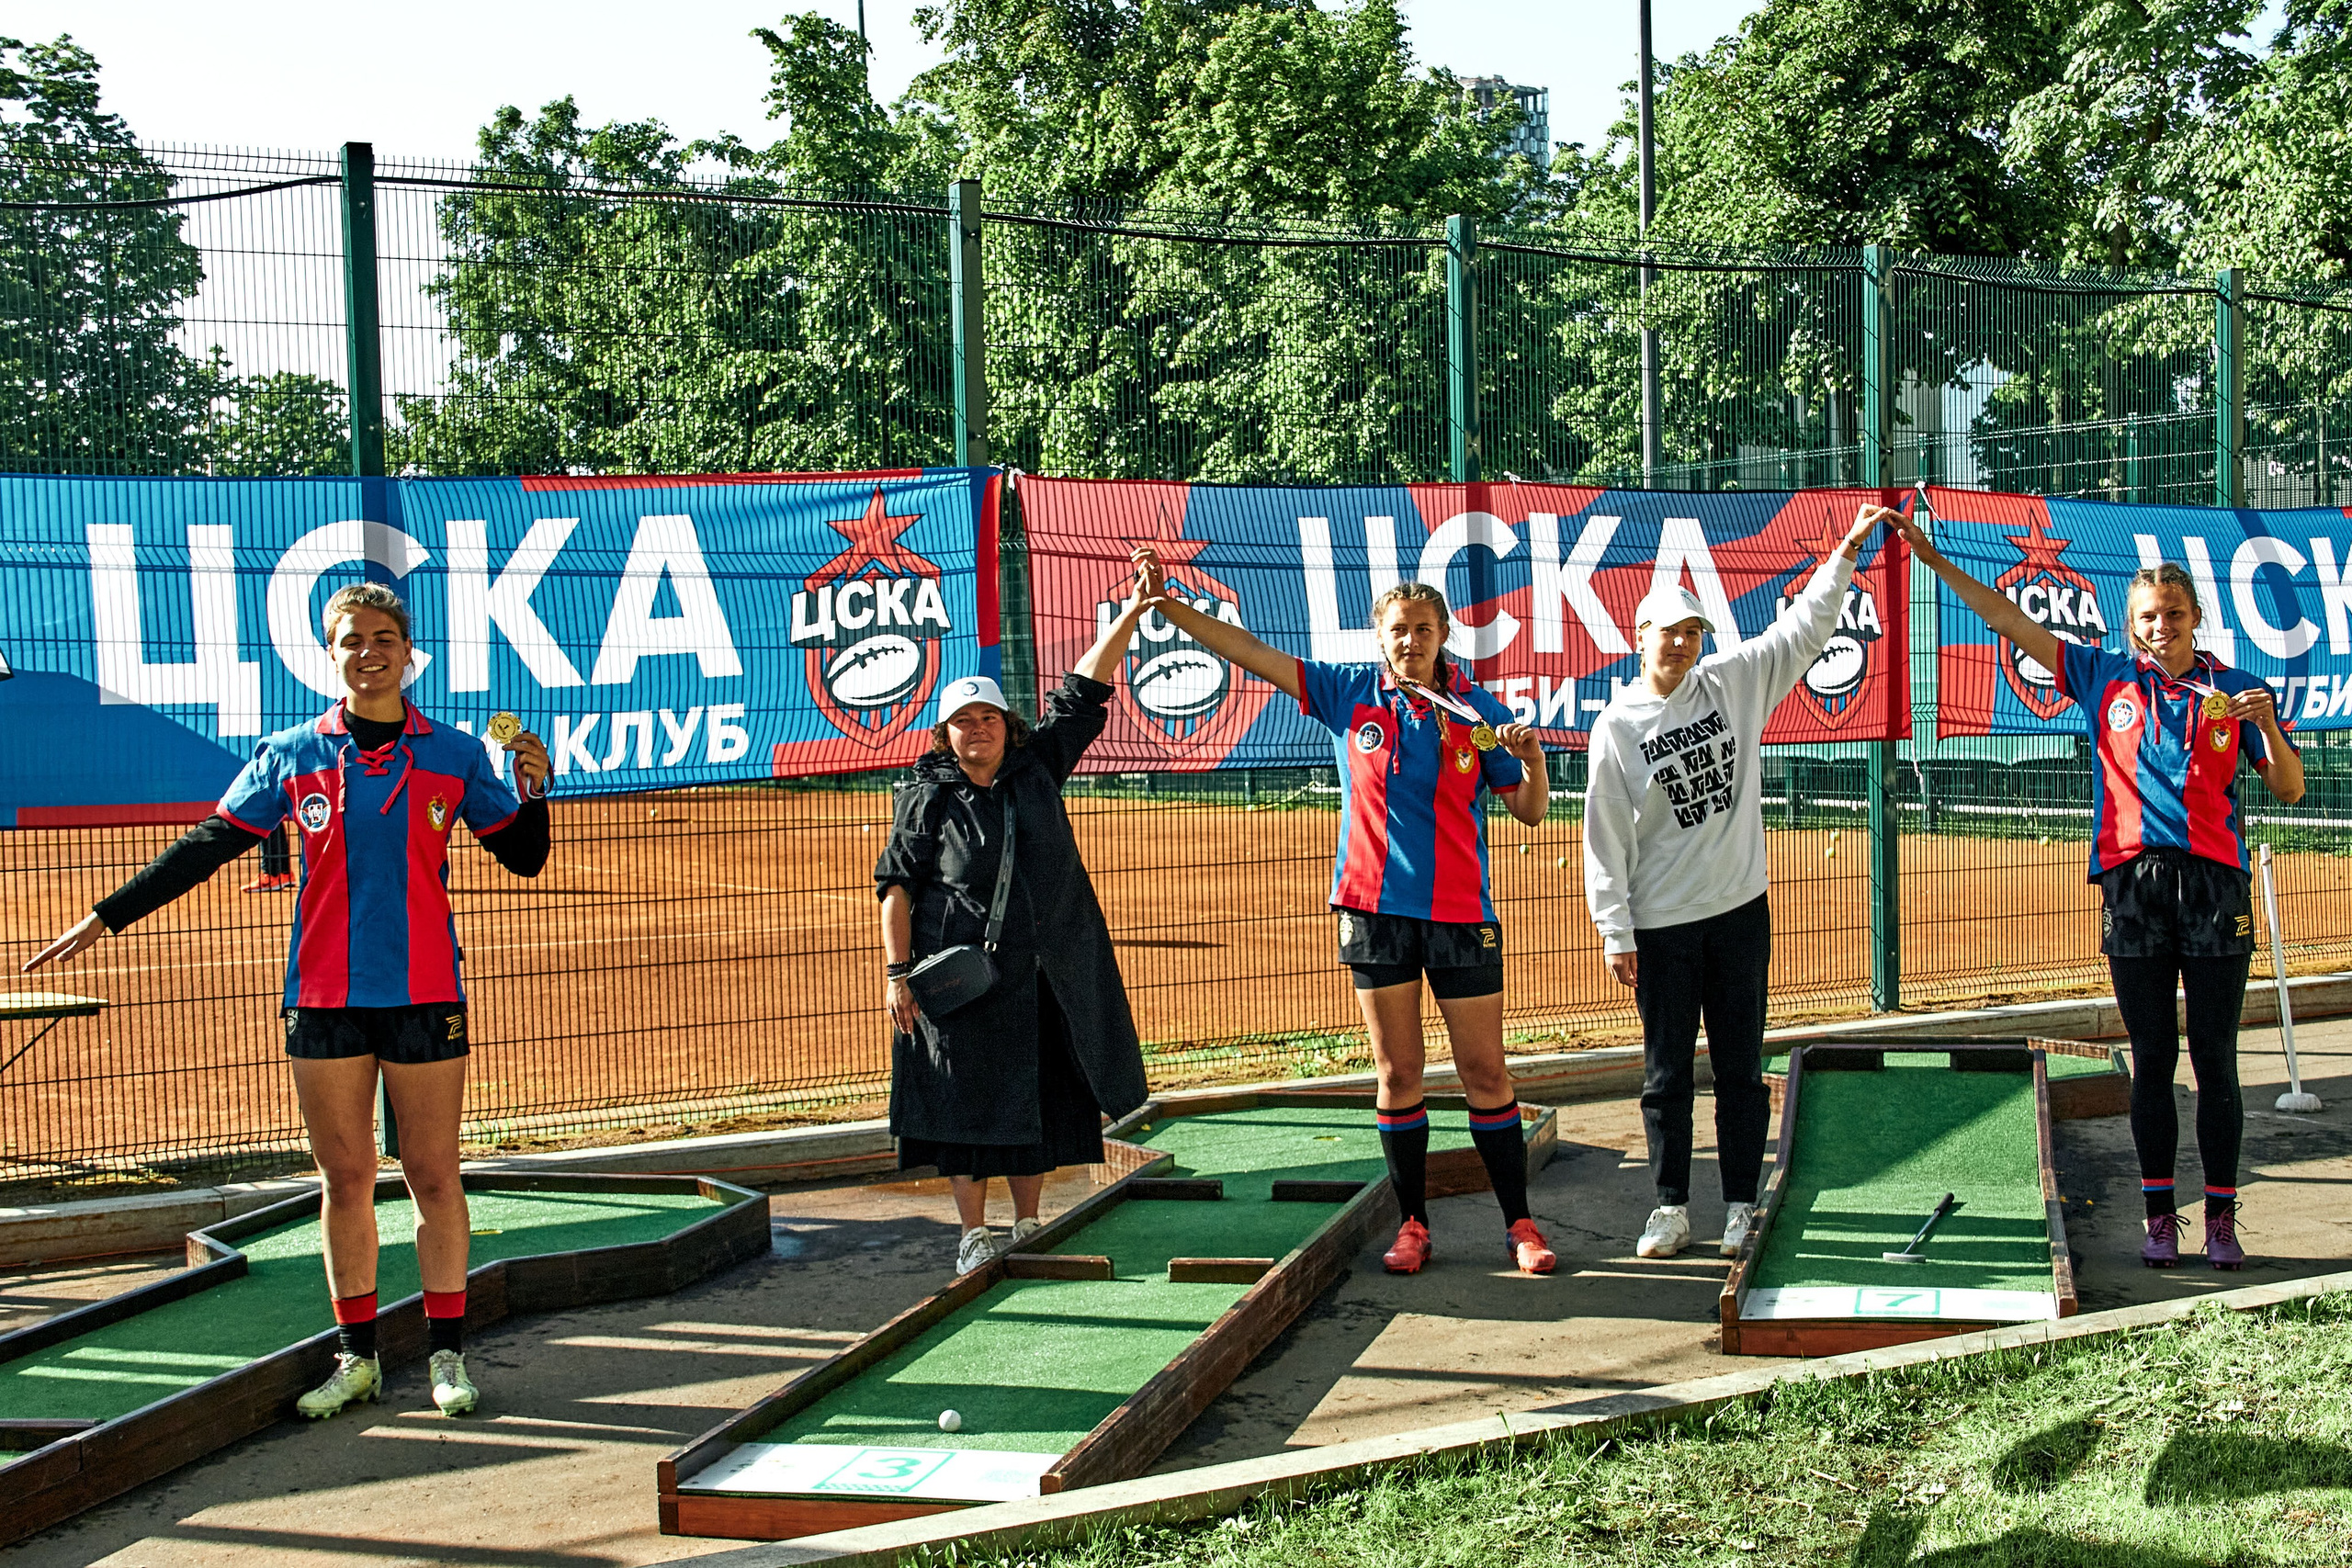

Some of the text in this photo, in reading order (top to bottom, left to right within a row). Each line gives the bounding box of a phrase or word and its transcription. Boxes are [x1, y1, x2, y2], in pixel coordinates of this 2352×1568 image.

[791, 578, 952, 642] ЦСКА
[1297, 512, 1743, 662] ЦСКА
[1988, 584, 2108, 632] СКА
[86, 514, 743, 736] ЦСКА
[1875, 1293, 1925, 1307] 7
[858, 1457, 922, 1479] 3
